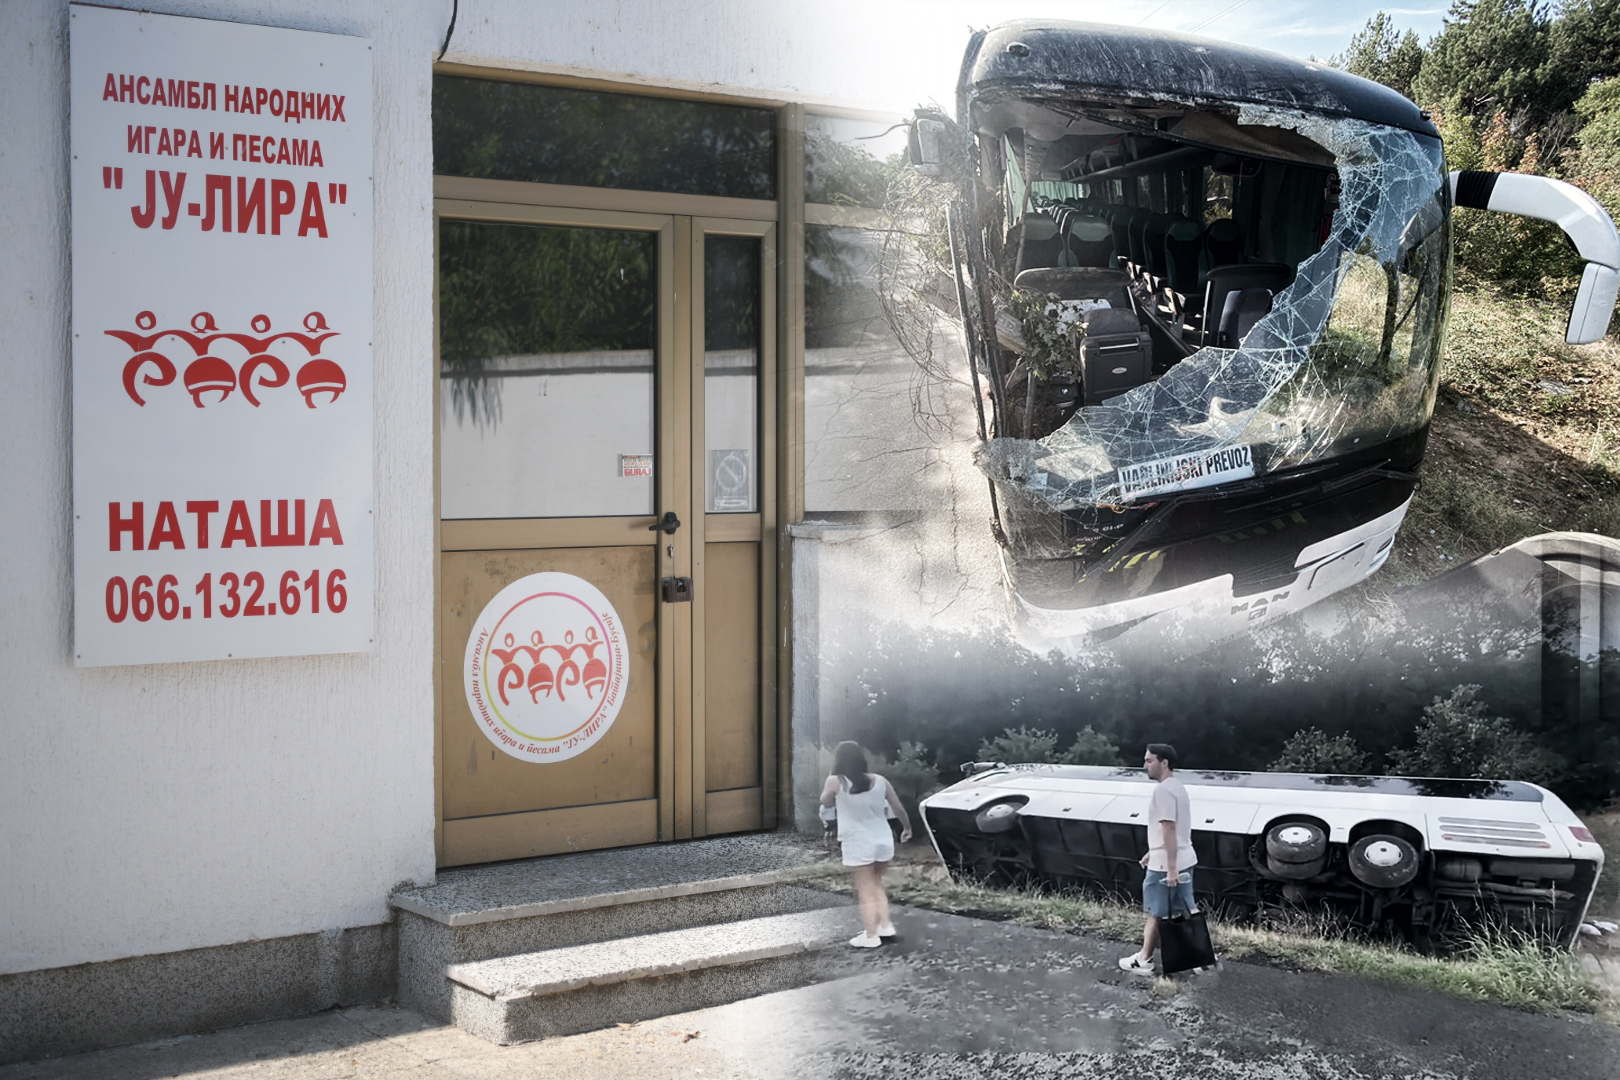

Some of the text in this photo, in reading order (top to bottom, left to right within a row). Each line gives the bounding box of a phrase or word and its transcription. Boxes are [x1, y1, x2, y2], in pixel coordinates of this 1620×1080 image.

[102, 73, 346, 124] АНСАМБЛ НАРОДНИХ
[127, 124, 324, 168] ИГАРА И ПЕСАМА
[1206, 446, 1251, 476] PREVOZ
[108, 498, 344, 552] НАТАША
[105, 568, 348, 624] 066.132.616
[1230, 590, 1291, 615] MAN
[472, 627, 489, 677] Ансамбл
[471, 680, 496, 728] народних
[493, 726, 517, 747] игара
[518, 743, 525, 751] и
[526, 743, 560, 755] песама
